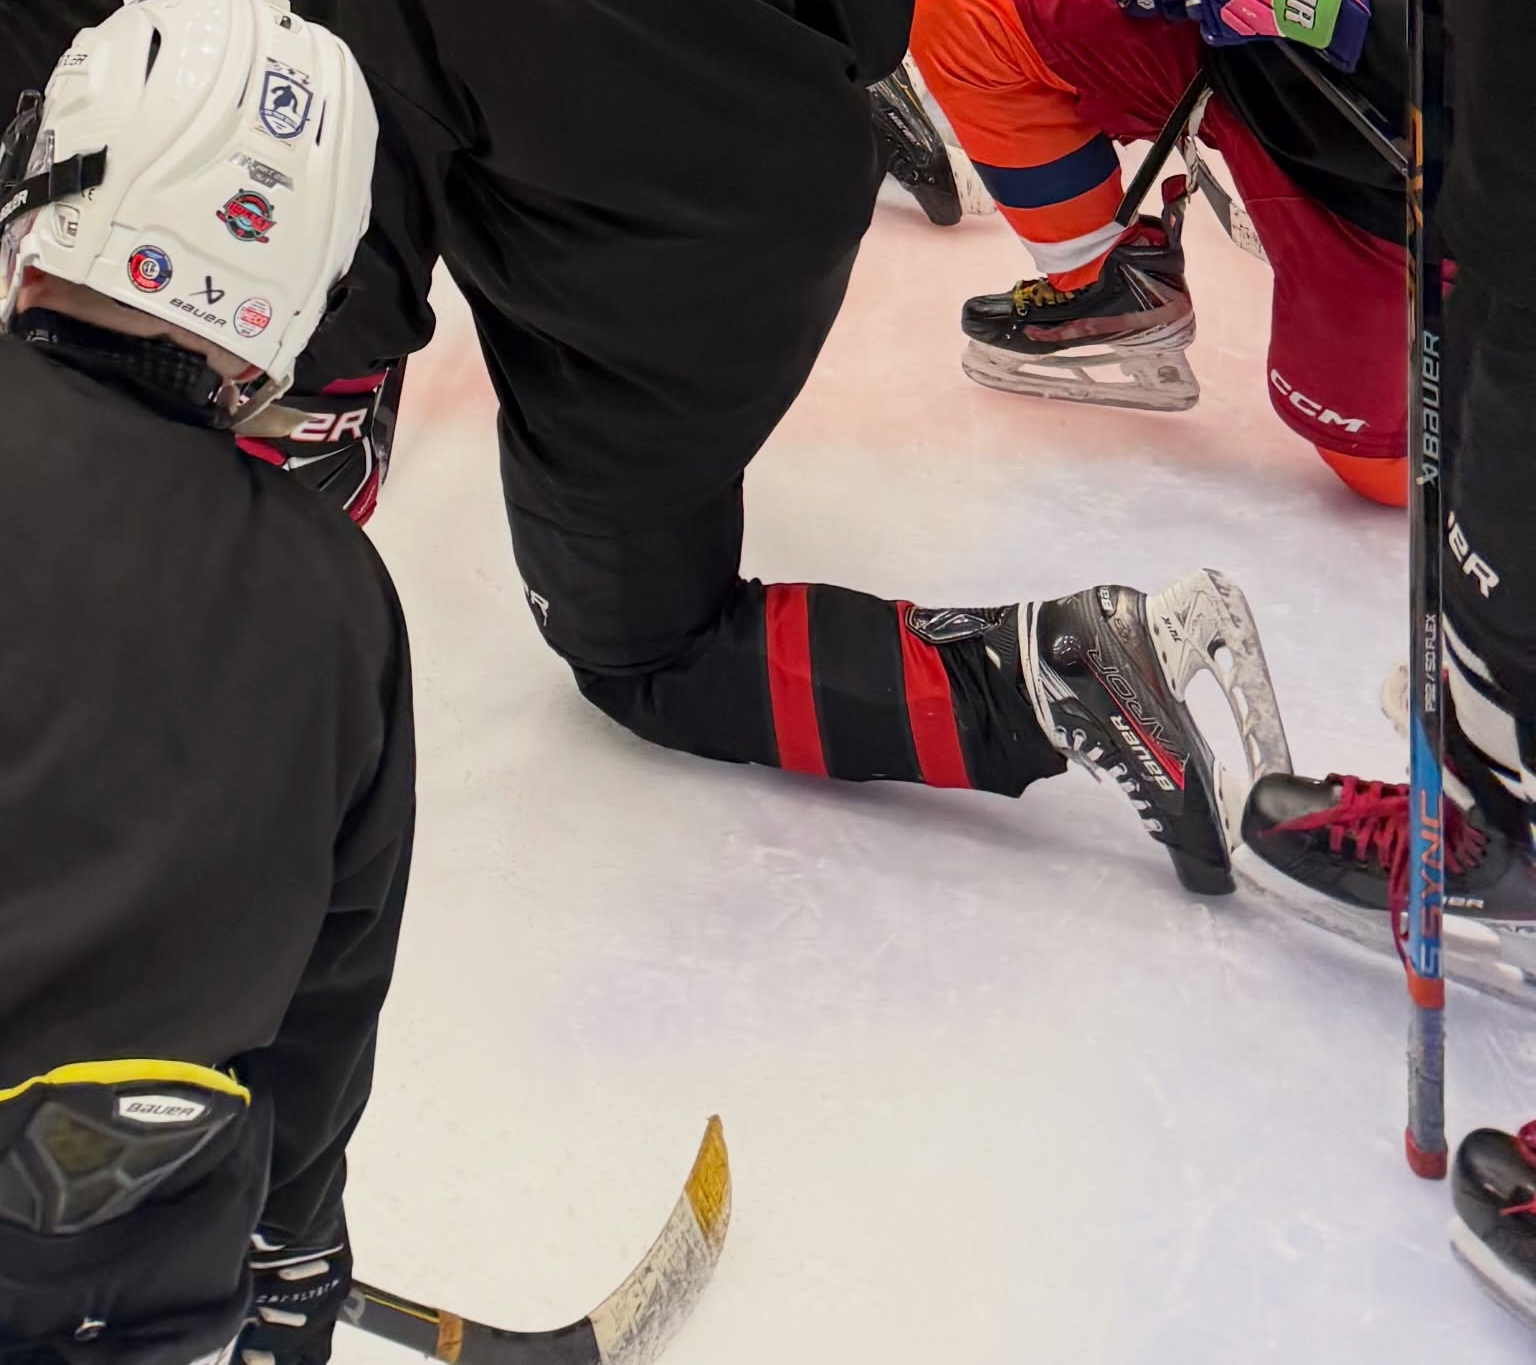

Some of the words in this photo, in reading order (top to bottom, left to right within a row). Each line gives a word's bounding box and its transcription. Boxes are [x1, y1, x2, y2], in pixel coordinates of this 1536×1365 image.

[169, 297, 227, 328] BAUER
[1269, 368, 1370, 434] CCM
[1421, 330, 1441, 462] BAUER
[1424, 613, 1438, 650] FLEX
[1110, 714, 1175, 793] BAUER
[125, 1101, 198, 1119] BAUER
